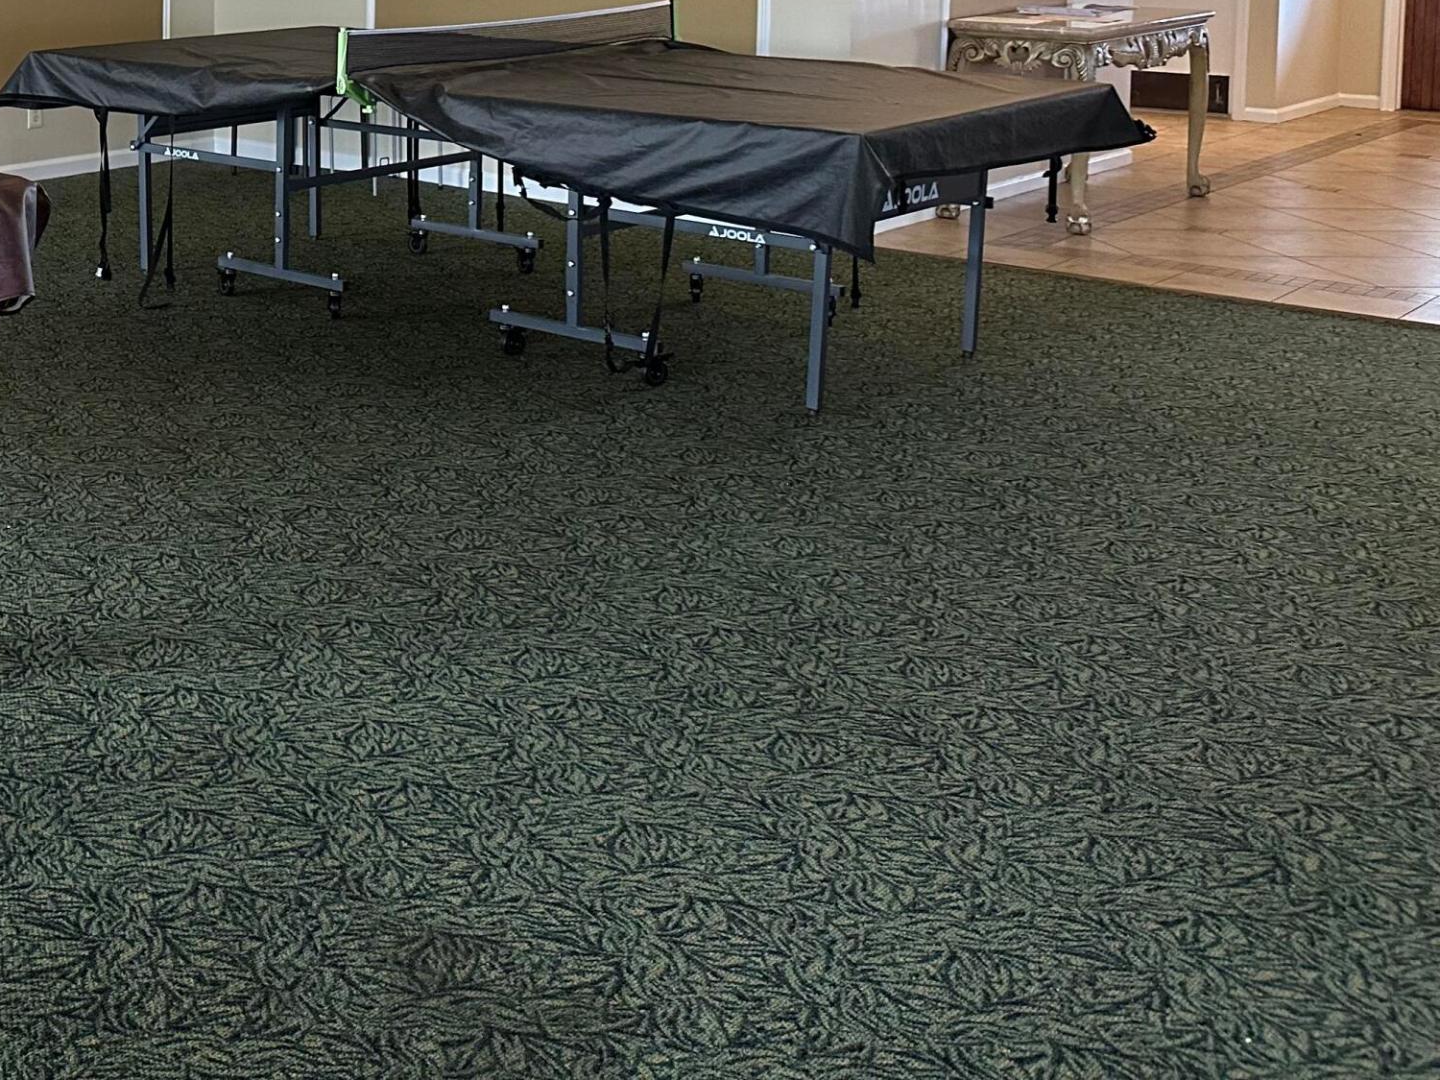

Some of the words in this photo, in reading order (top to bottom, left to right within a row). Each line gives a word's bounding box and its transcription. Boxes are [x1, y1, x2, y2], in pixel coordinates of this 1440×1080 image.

[171, 148, 199, 160] JOOLA
[894, 181, 939, 209] OOLA
[719, 228, 766, 244] JOOLA
